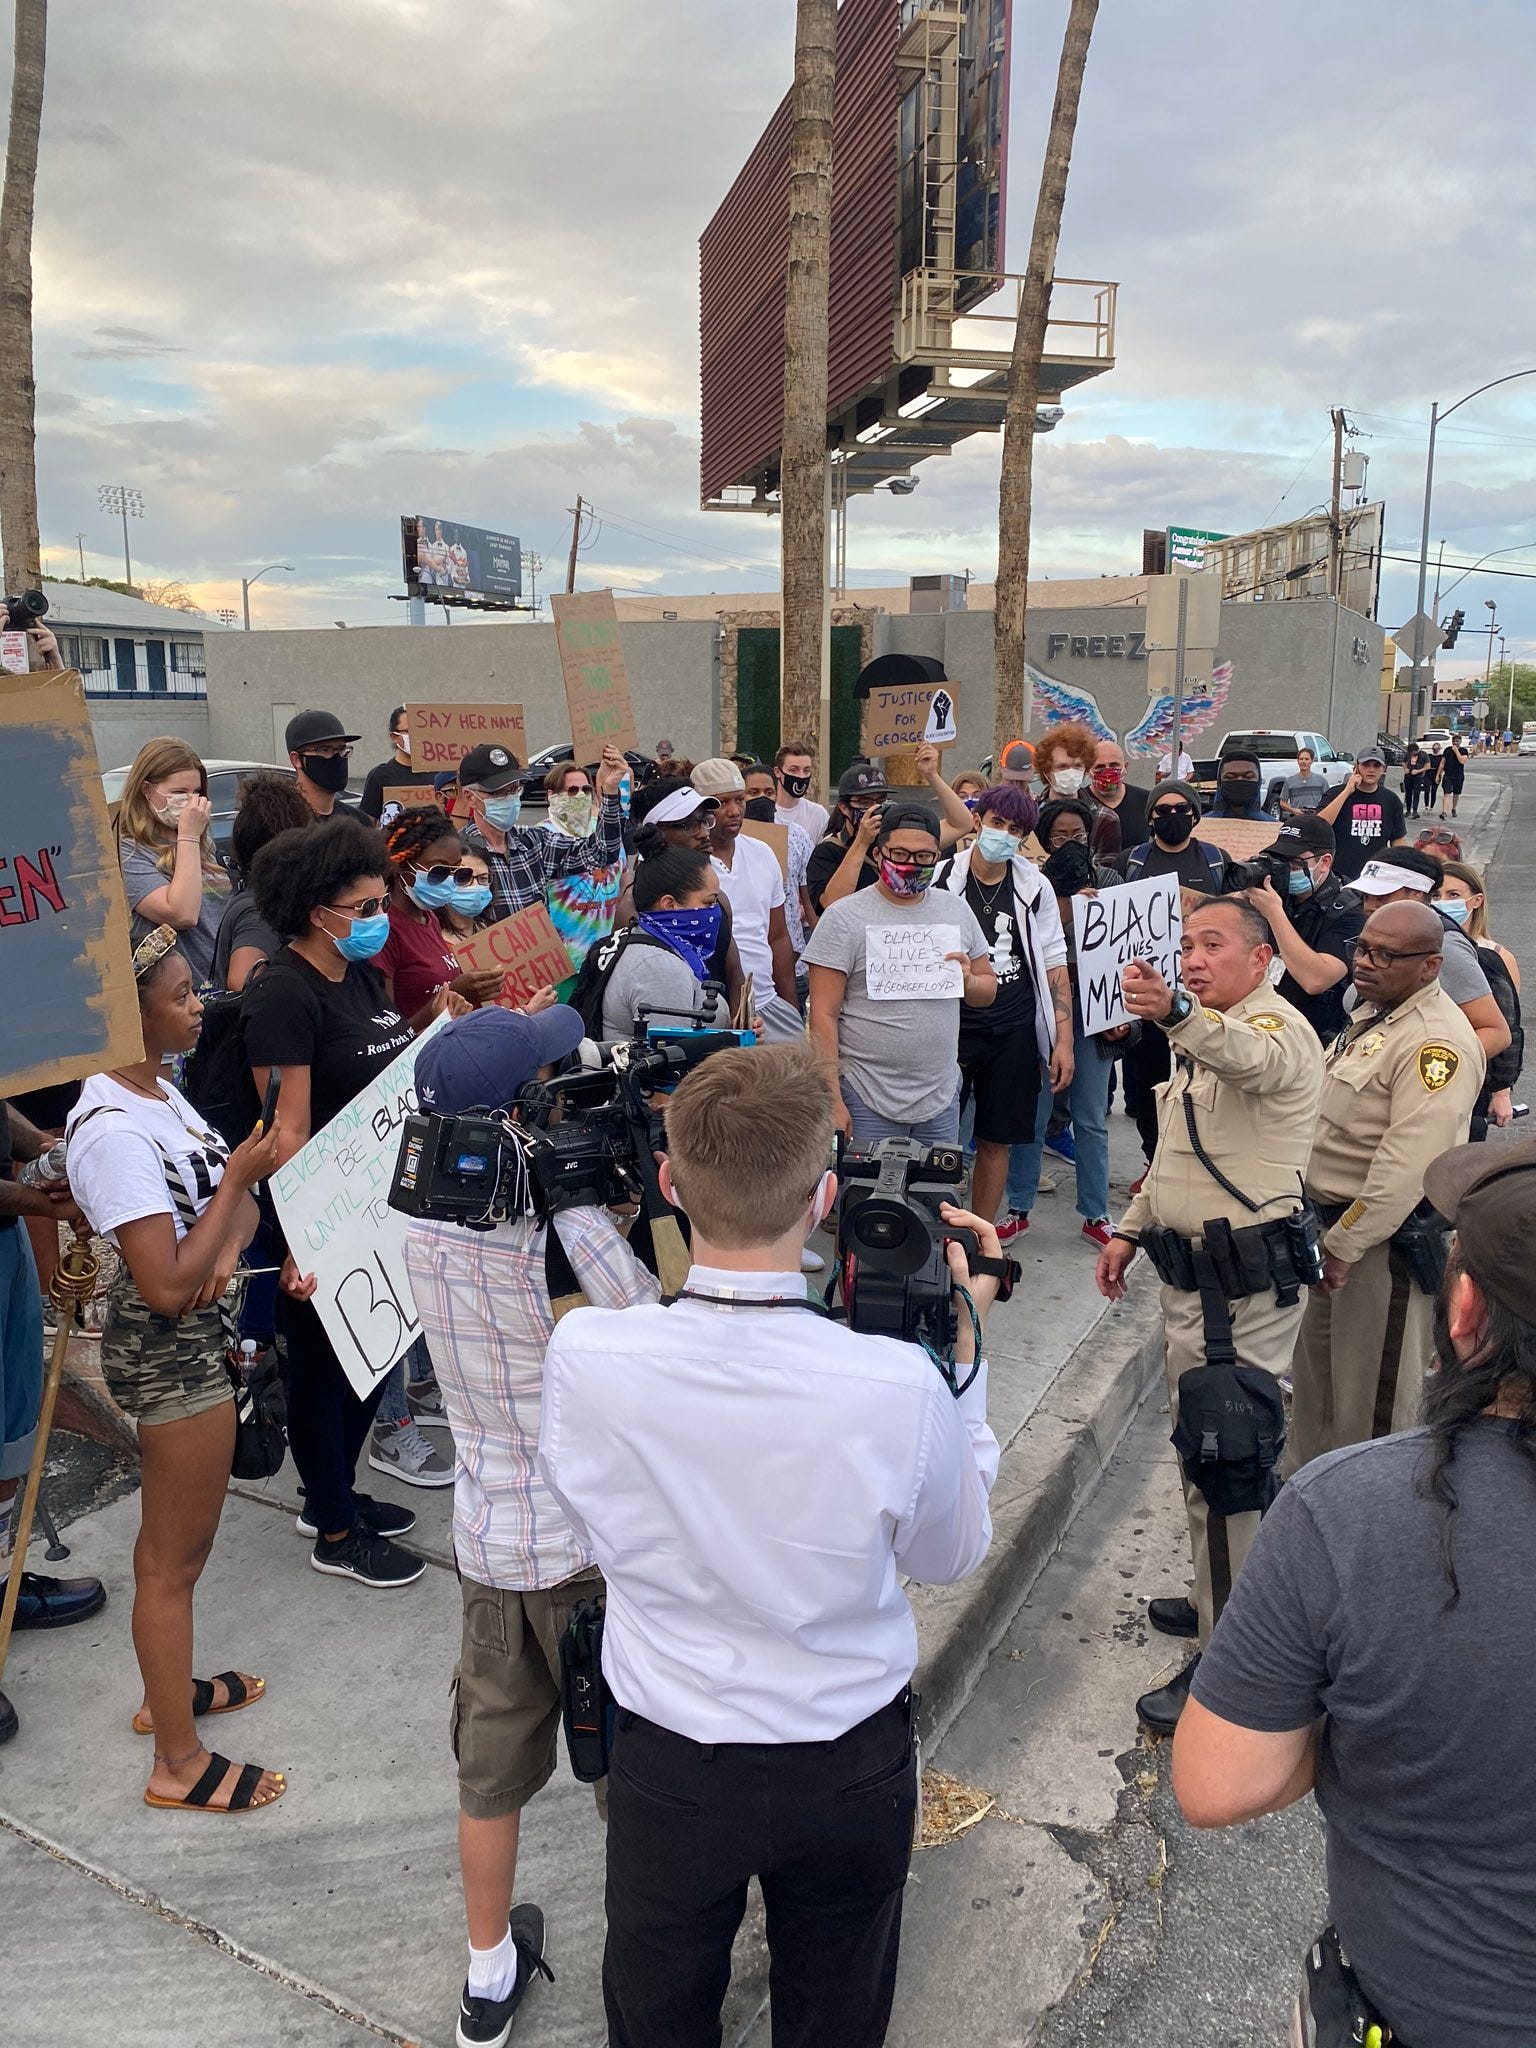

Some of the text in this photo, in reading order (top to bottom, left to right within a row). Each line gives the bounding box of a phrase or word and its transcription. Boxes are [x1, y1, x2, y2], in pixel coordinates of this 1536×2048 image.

[1048, 632, 1148, 662] FREEZ
[878, 691, 932, 708] JUSTICE
[416, 711, 524, 730] SAY HER NAME
[895, 714, 916, 725] FOR
[874, 731, 923, 746] GEORGE
[1352, 803, 1382, 820] GO
[1350, 828, 1382, 837] CURE
[1351, 820, 1383, 828] FIGHT
[1081, 891, 1180, 952] BLACK
[457, 942, 479, 972] I
[488, 907, 552, 965] CAN'T
[882, 929, 935, 946] BLACK
[888, 946, 942, 961] LIVES
[1118, 938, 1153, 964] LIVES
[873, 980, 955, 994] #GEORGEFLOYD
[1086, 949, 1184, 1027] MAER
[366, 1042, 391, 1056] Rosa
[275, 1096, 370, 1203] EVERYONE
[333, 1139, 367, 1177] BE
[564, 1161, 578, 1170] JVC
[303, 1188, 365, 1251] UNTIL
[361, 1196, 390, 1229] TO
[334, 1249, 420, 1378] BL
